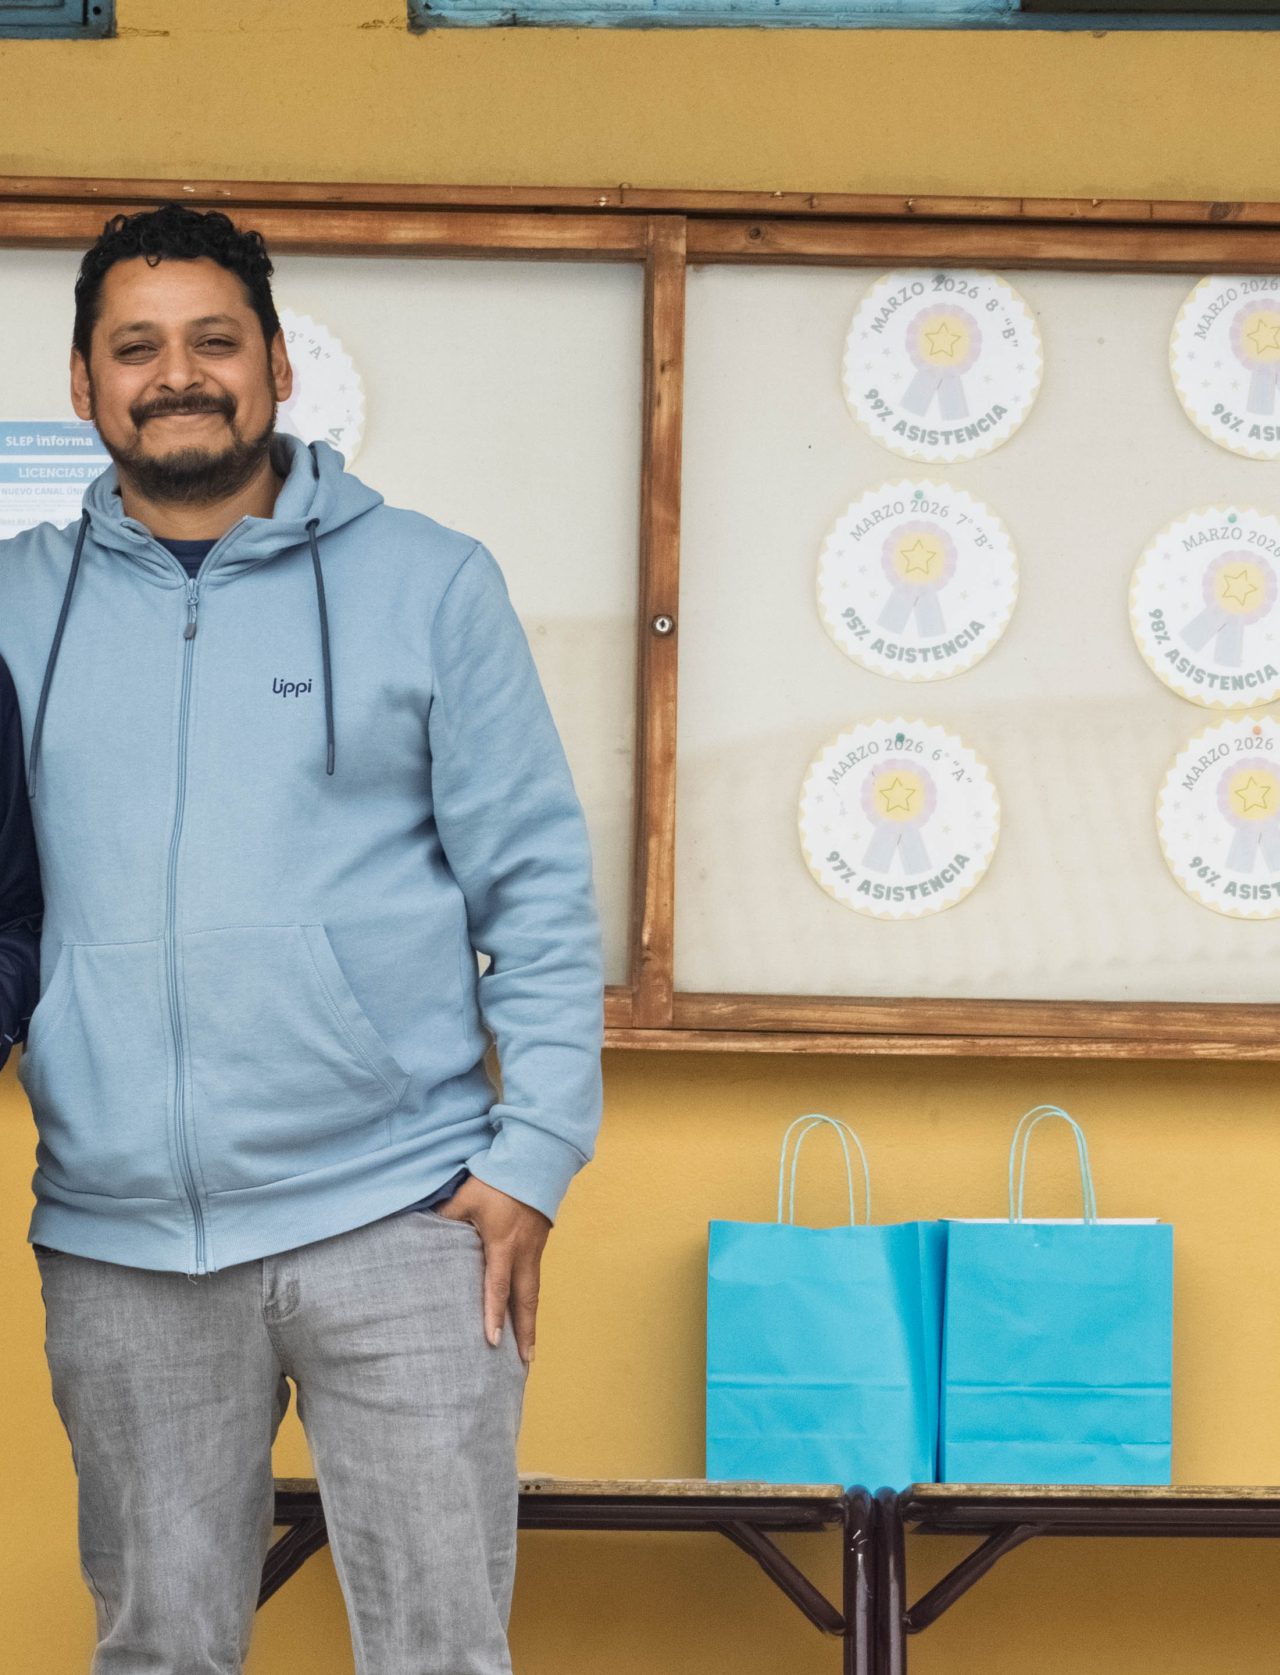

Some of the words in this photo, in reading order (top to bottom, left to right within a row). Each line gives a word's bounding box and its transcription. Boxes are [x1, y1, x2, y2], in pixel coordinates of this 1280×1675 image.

[871, 282, 925, 334] MARZO
[931, 278, 980, 300] 2026
[1194, 288, 1238, 340] MARZO
[1240, 278, 1280, 296] 2026
[864, 388, 894, 422] 99%
[892, 404, 1008, 446] ASISTENCIA
[1211, 403, 1245, 433] 96%
[5, 436, 34, 447] SLEP
[36, 434, 94, 447] informa
[1, 488, 32, 497] NUEVO
[34, 488, 64, 497] CANAL
[18, 467, 84, 478] LICENCIAS
[849, 501, 905, 542] MARZO
[910, 499, 950, 518] 2026
[1181, 527, 1243, 552] MARZO
[841, 607, 871, 641] 95%
[870, 620, 986, 663] ASISTENCIA
[1148, 609, 1171, 645] 98%
[1164, 649, 1279, 691] ASISTENCIA
[273, 677, 312, 698] lippi
[827, 741, 879, 786] MARZO
[884, 738, 924, 754] 2026
[1181, 743, 1231, 791] MARZO
[1234, 737, 1274, 751] 2026
[826, 851, 856, 884] 97%
[857, 853, 971, 902] ASISTENCIA
[1189, 856, 1221, 888] 96%
